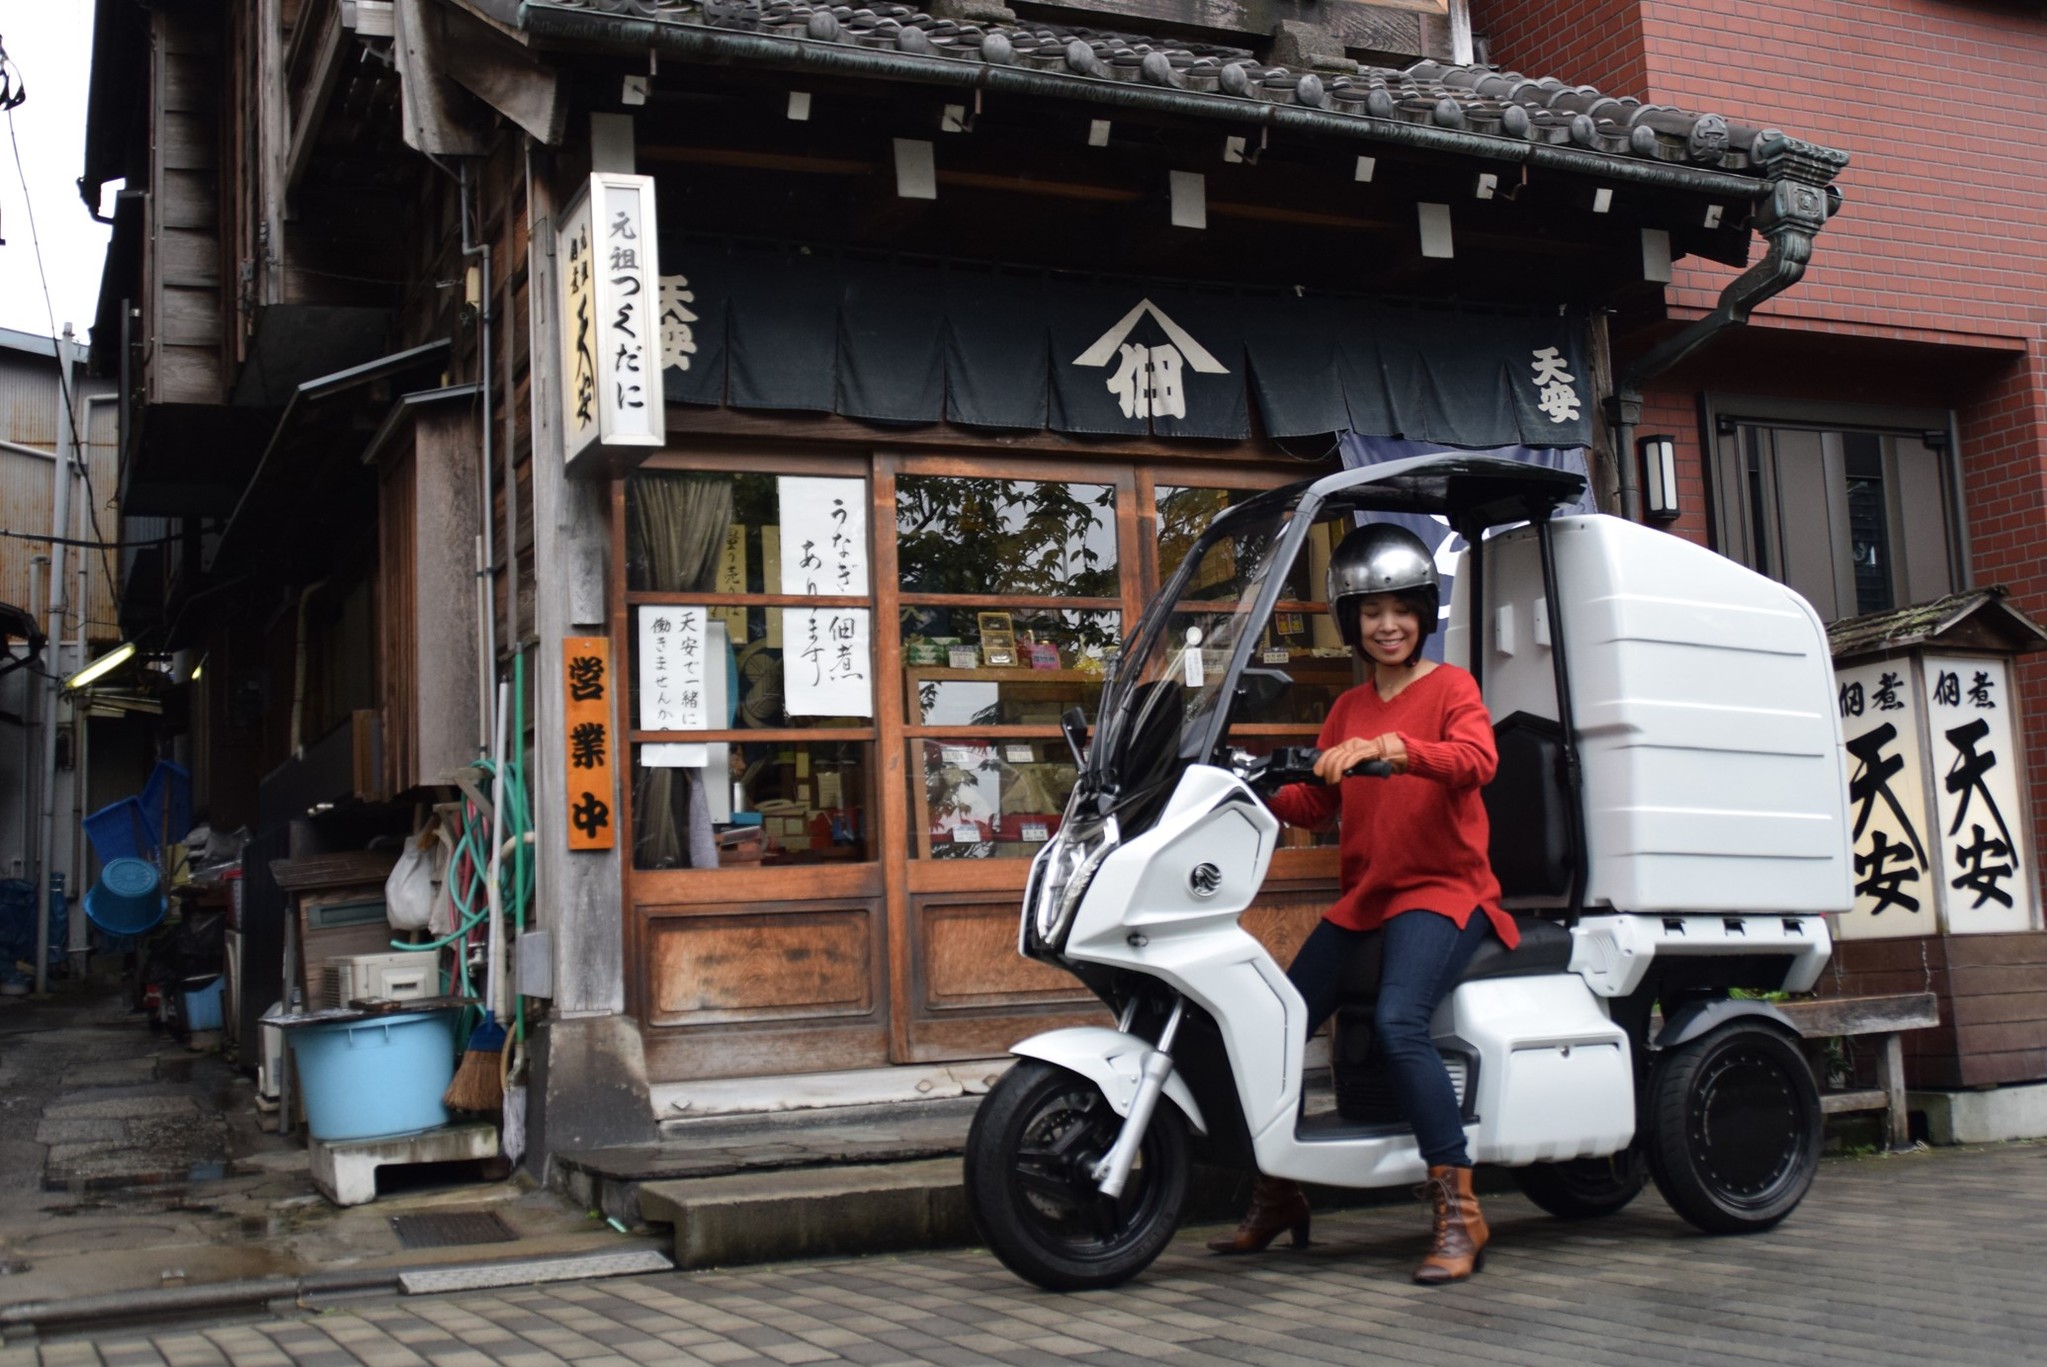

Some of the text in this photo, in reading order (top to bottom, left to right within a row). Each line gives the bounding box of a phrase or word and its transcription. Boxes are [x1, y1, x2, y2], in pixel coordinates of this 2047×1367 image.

[609, 211, 644, 409] 元祖つくだに
[1531, 347, 1582, 423] 天安
[569, 656, 609, 839] 営業中
[679, 612, 700, 726] 天安で一緒に
[1933, 670, 1996, 709] 佃煮
[1846, 722, 1929, 916] 天安
[1945, 717, 2019, 909] 天安
